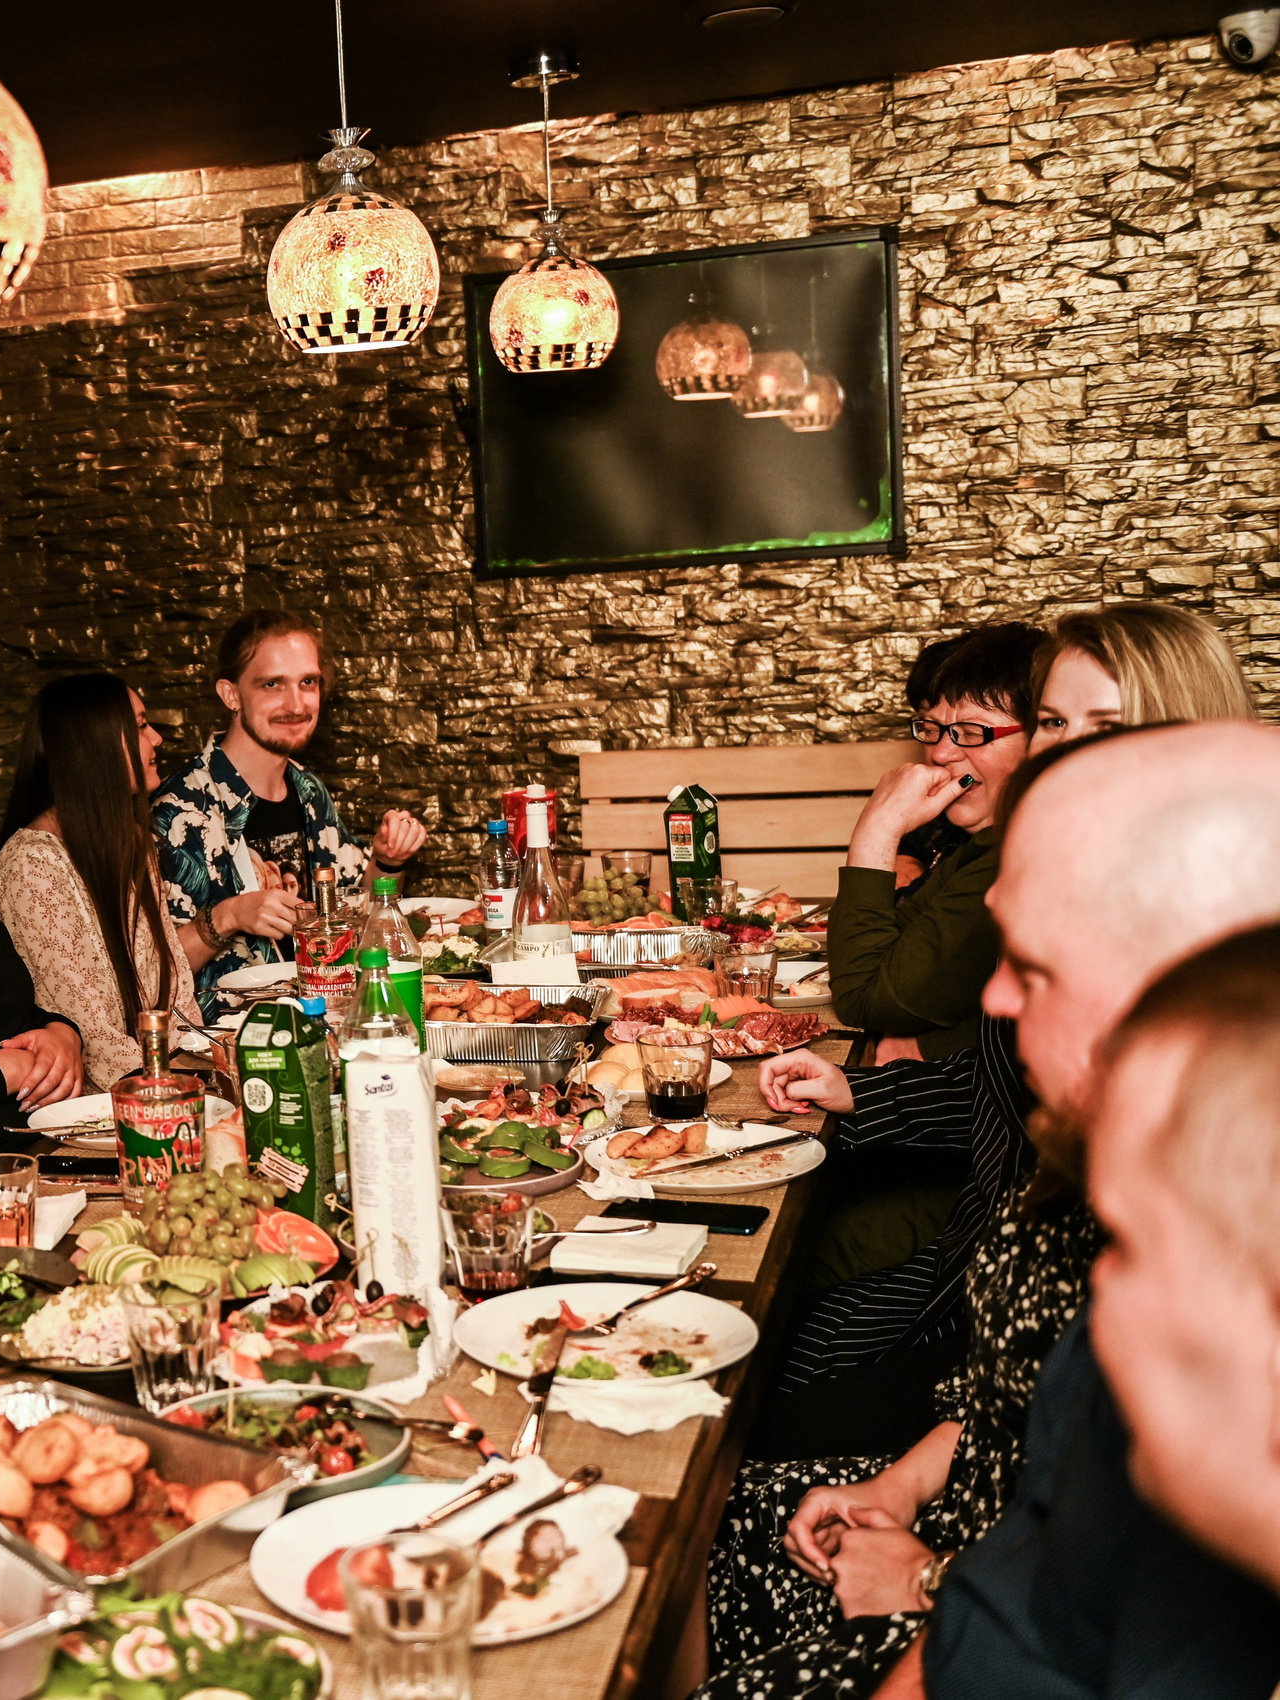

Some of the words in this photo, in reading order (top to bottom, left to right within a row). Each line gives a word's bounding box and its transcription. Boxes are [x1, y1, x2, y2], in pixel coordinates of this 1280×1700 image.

[516, 944, 540, 952] CAMPO
[317, 982, 352, 991] INGREDIENTS
[364, 1083, 394, 1096] Santal
[142, 1100, 198, 1120] BABOON
[120, 1146, 186, 1187] PINK
